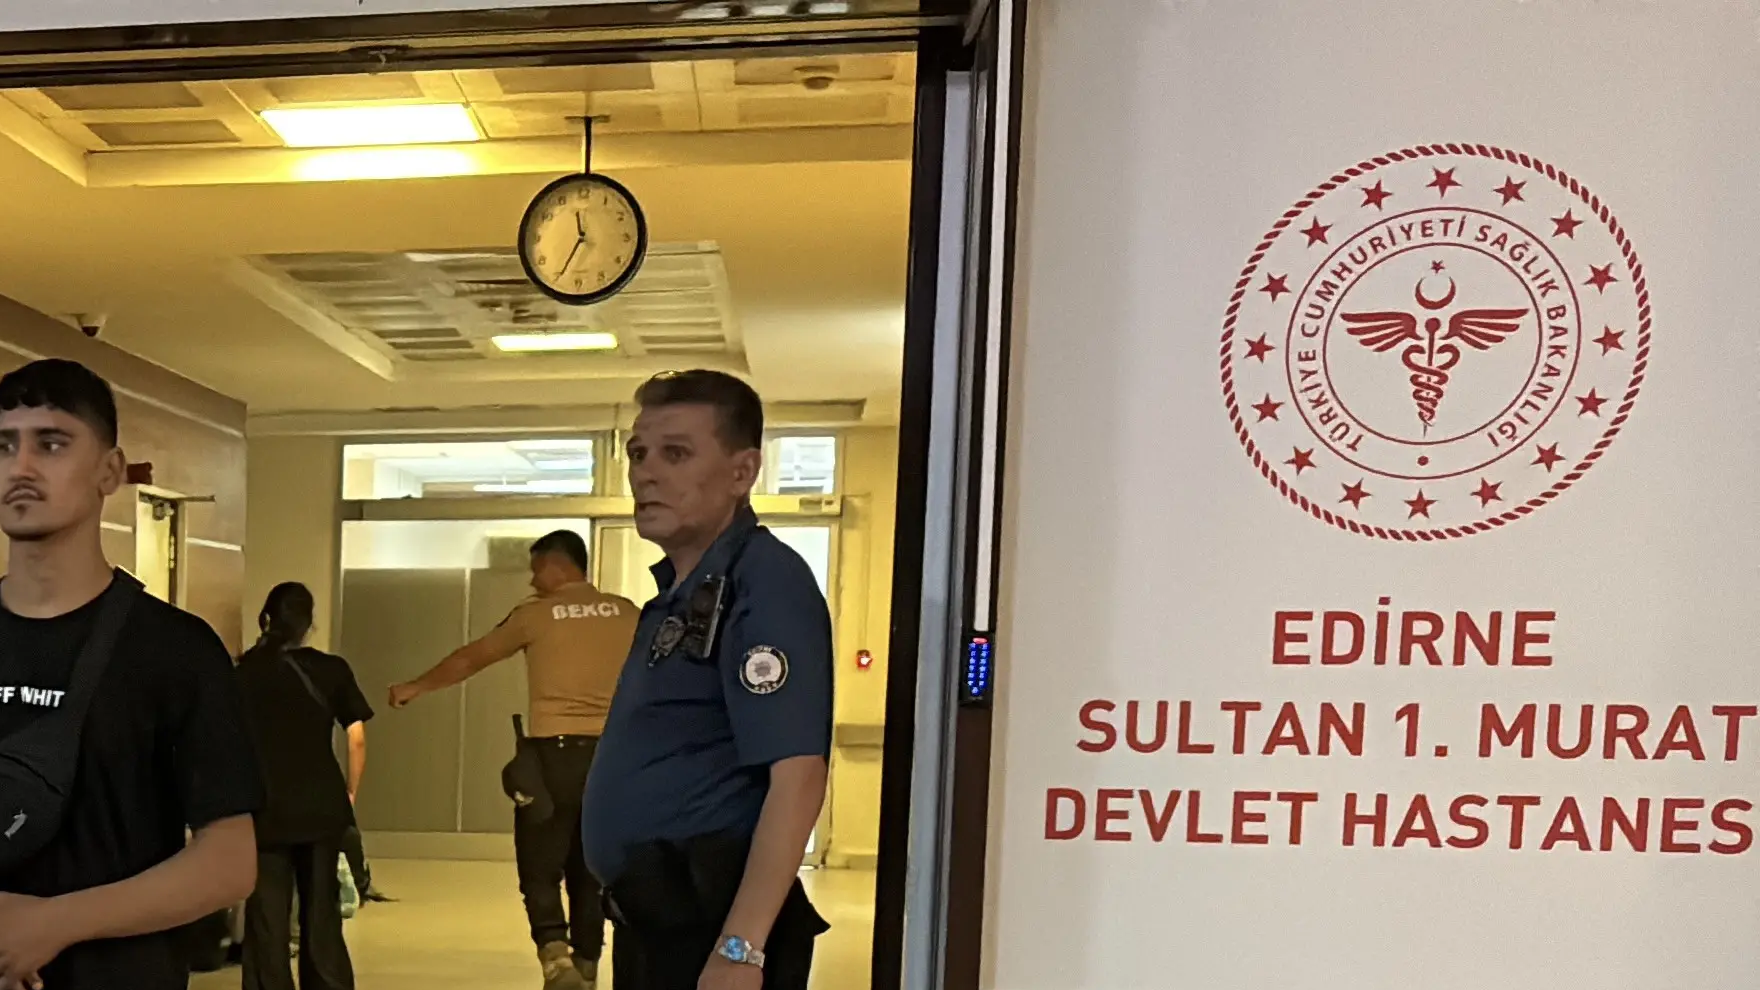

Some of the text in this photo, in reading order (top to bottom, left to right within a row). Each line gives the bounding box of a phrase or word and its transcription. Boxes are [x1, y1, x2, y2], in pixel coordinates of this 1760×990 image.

[1298, 214, 1569, 453] TÜRKİYE CUMHURİYETİ SAĞLIK BAKANLIĞI
[1271, 596, 1557, 667] EDİRNE
[20, 685, 66, 708] WHIT
[1076, 698, 1758, 762] SULTAN 1. MURAT
[1044, 786, 1755, 855] DEVLET HASTANES
